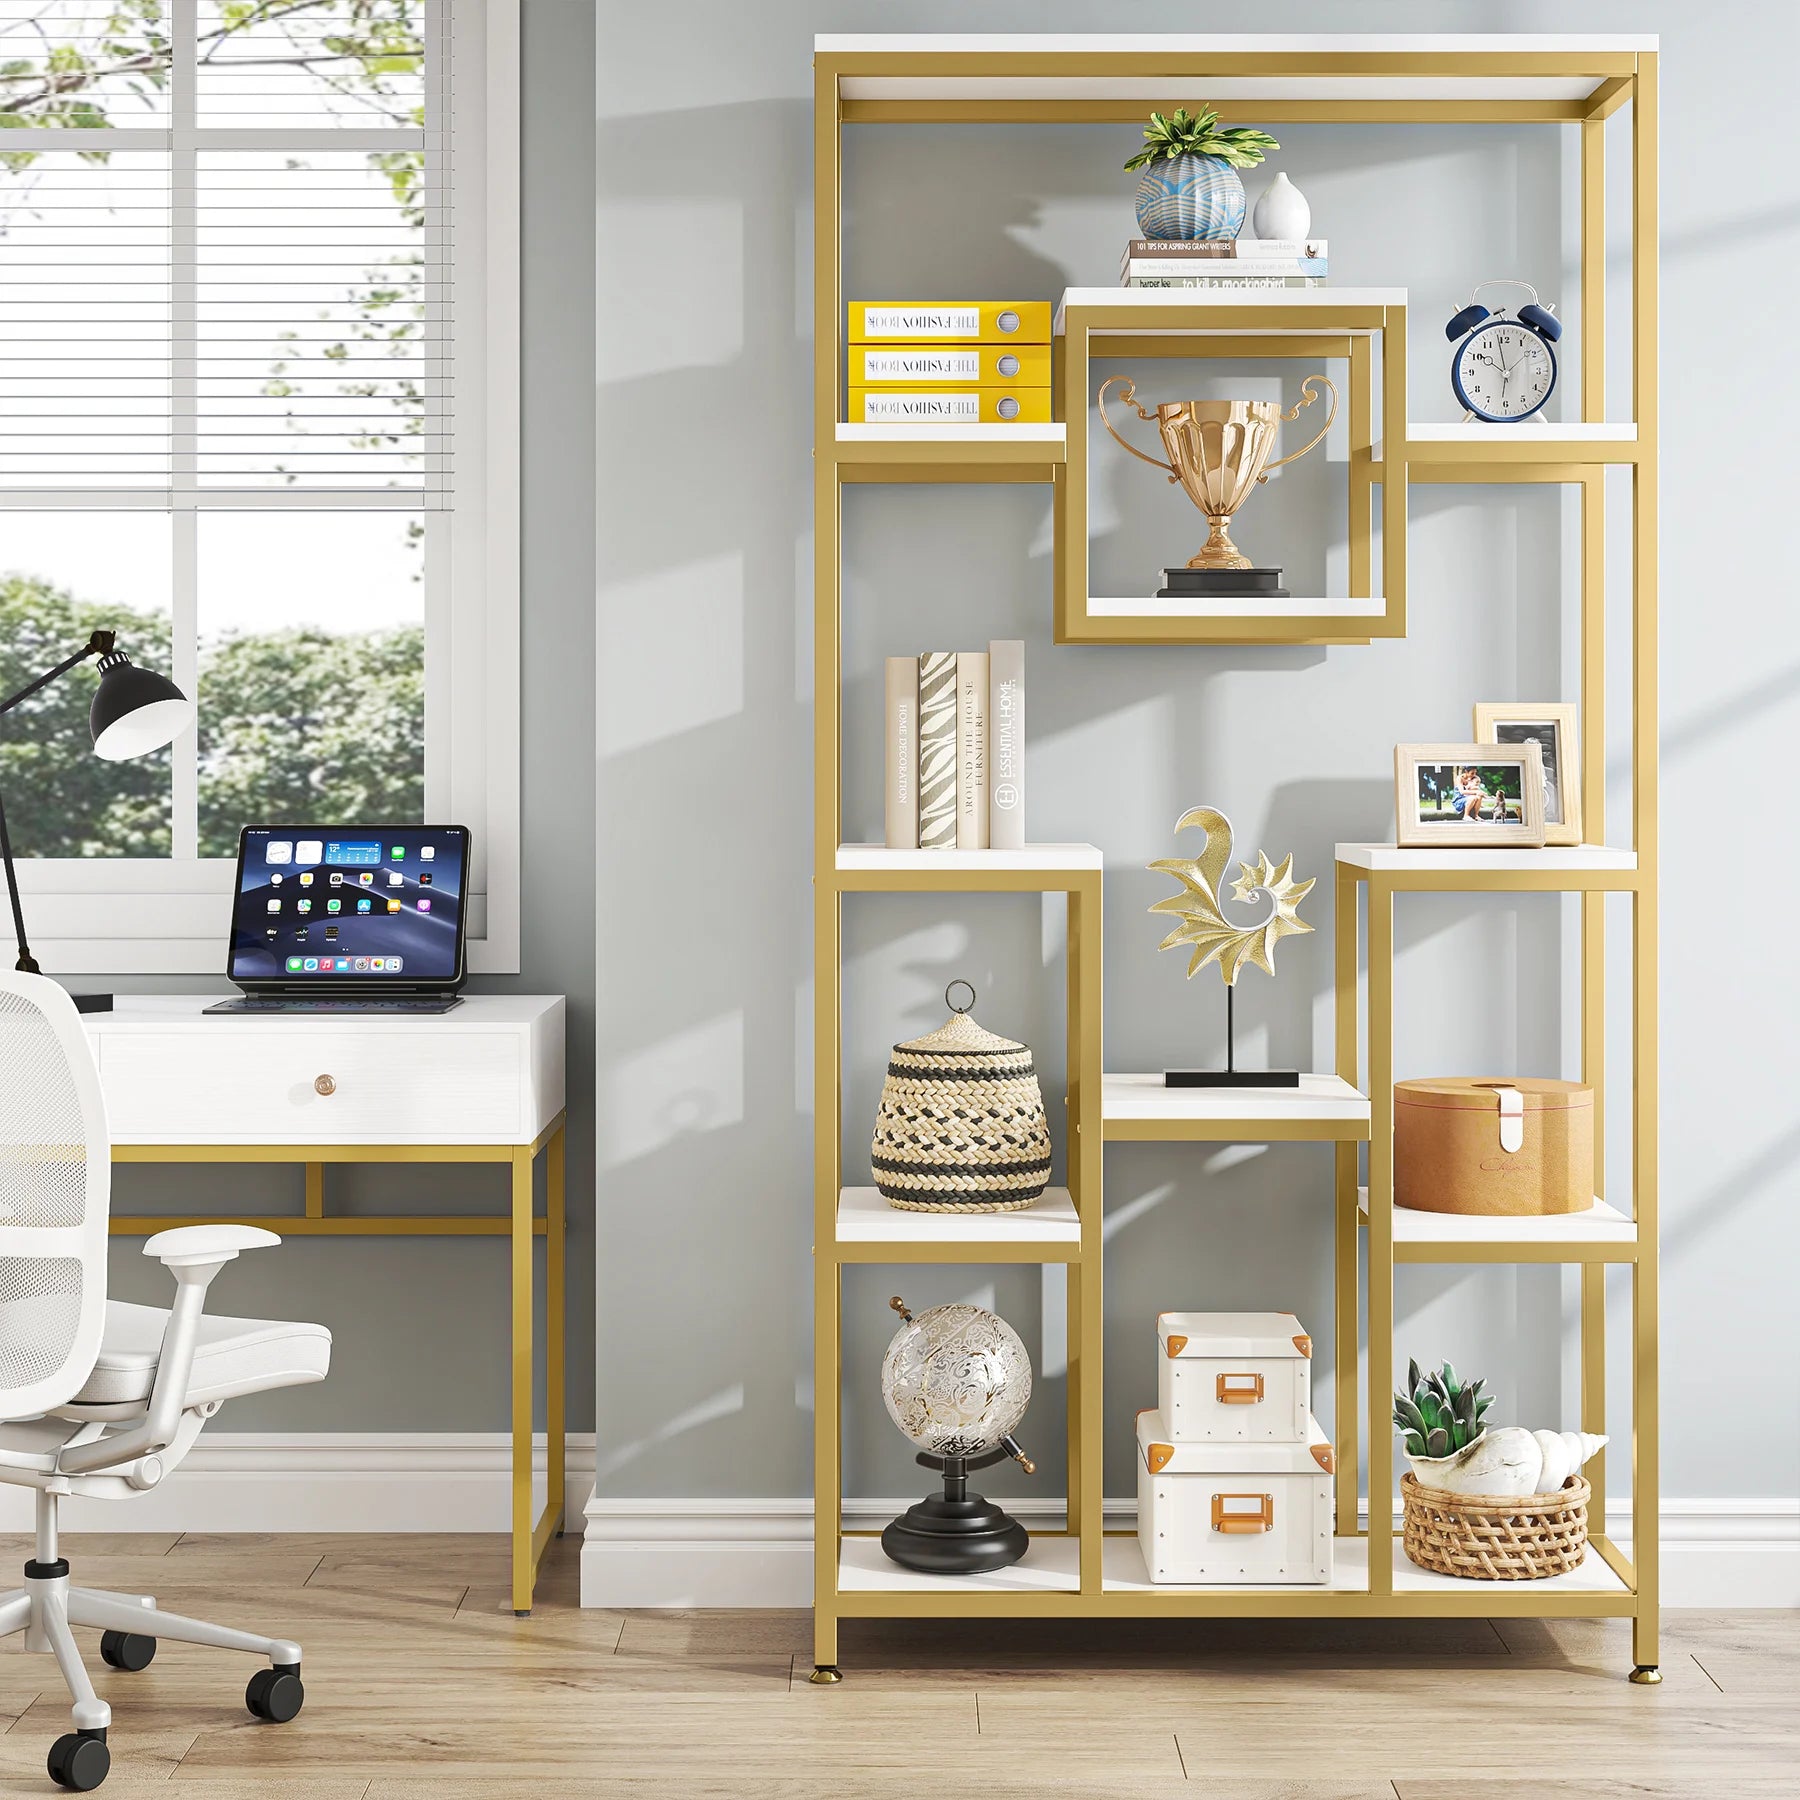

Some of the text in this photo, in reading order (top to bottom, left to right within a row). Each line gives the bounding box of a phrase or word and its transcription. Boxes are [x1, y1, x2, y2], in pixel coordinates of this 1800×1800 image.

[1140, 278, 1170, 288] harper lee
[1183, 278, 1193, 288] to
[1197, 278, 1209, 288] kill
[1222, 278, 1285, 288] mockingbird
[868, 316, 978, 328] THE FASHION BOOK
[868, 360, 978, 372] THE FASHION BOOK
[868, 403, 978, 414] THE FASHION BOOK
[1000, 680, 1012, 777] ESSENTIAL HOME
[899, 704, 908, 804] HOME DECORATION
